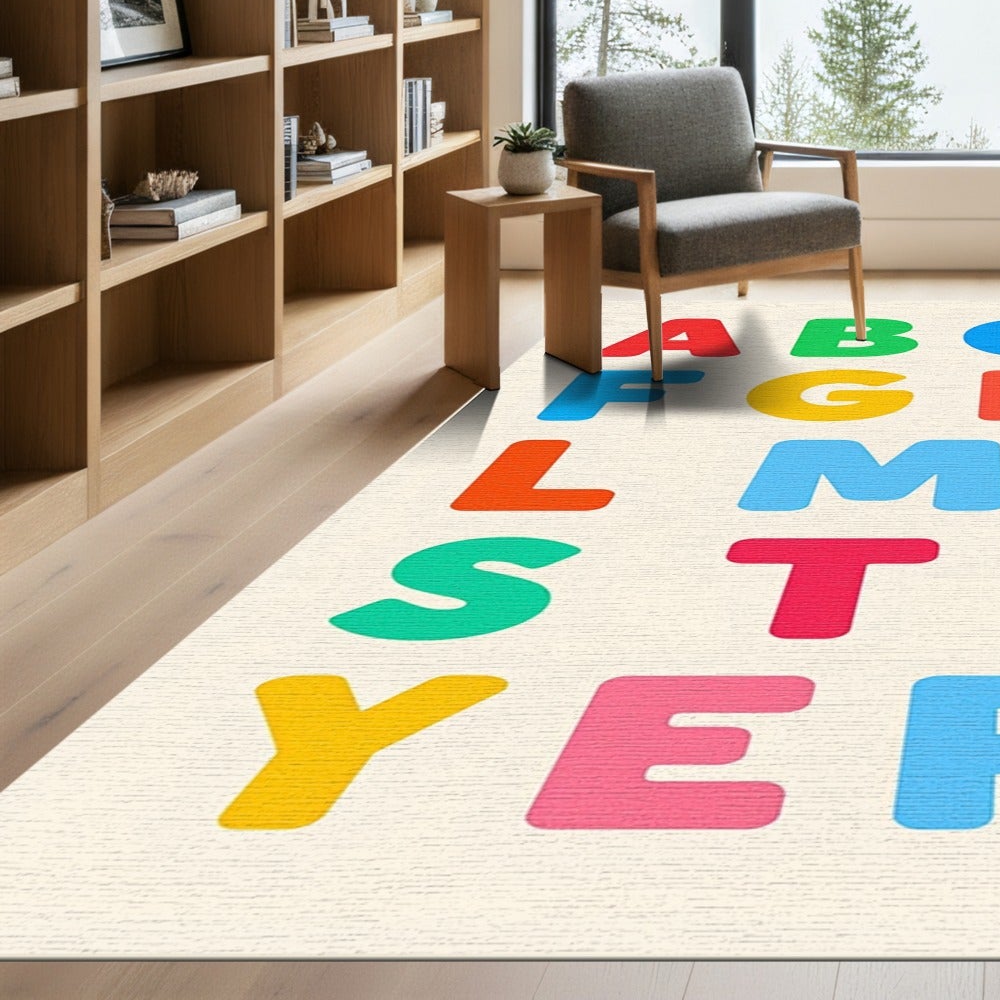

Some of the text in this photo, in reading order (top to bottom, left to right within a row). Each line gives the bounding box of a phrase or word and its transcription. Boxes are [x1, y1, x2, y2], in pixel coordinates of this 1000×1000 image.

[602, 318, 741, 358] A
[791, 318, 918, 358] B
[537, 370, 705, 422] F
[746, 369, 914, 422] G
[450, 440, 615, 511] L
[329, 537, 580, 641] S
[726, 538, 940, 639] T
[217, 674, 509, 830] Y
[527, 676, 814, 830] E
